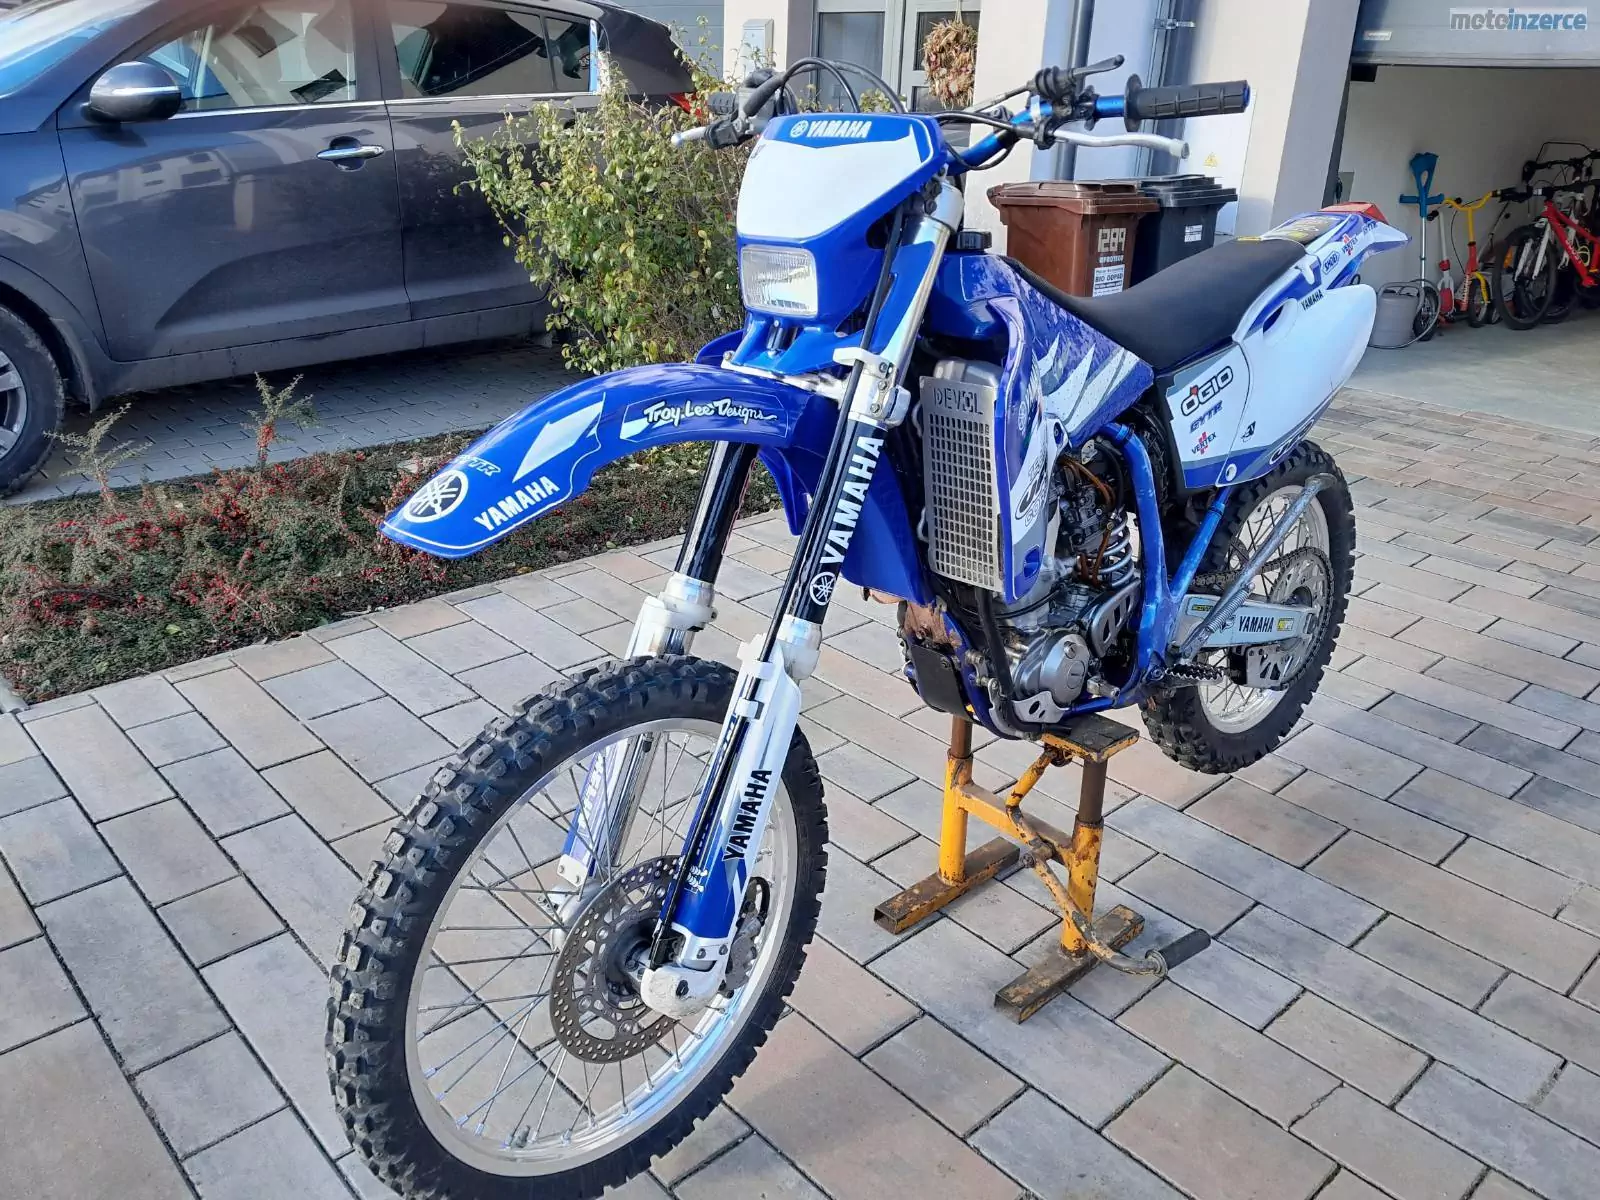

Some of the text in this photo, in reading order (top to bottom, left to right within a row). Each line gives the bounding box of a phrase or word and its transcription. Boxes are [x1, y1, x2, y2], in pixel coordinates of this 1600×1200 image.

[806, 120, 872, 138] YAMAHA
[1301, 289, 1324, 311] YAMAHA
[714, 398, 778, 424] Designs
[473, 475, 560, 531] YAMAHA
[820, 436, 885, 564] YAMAHA
[1239, 616, 1274, 633] YAMAHA
[722, 770, 773, 861] YAMAHA
